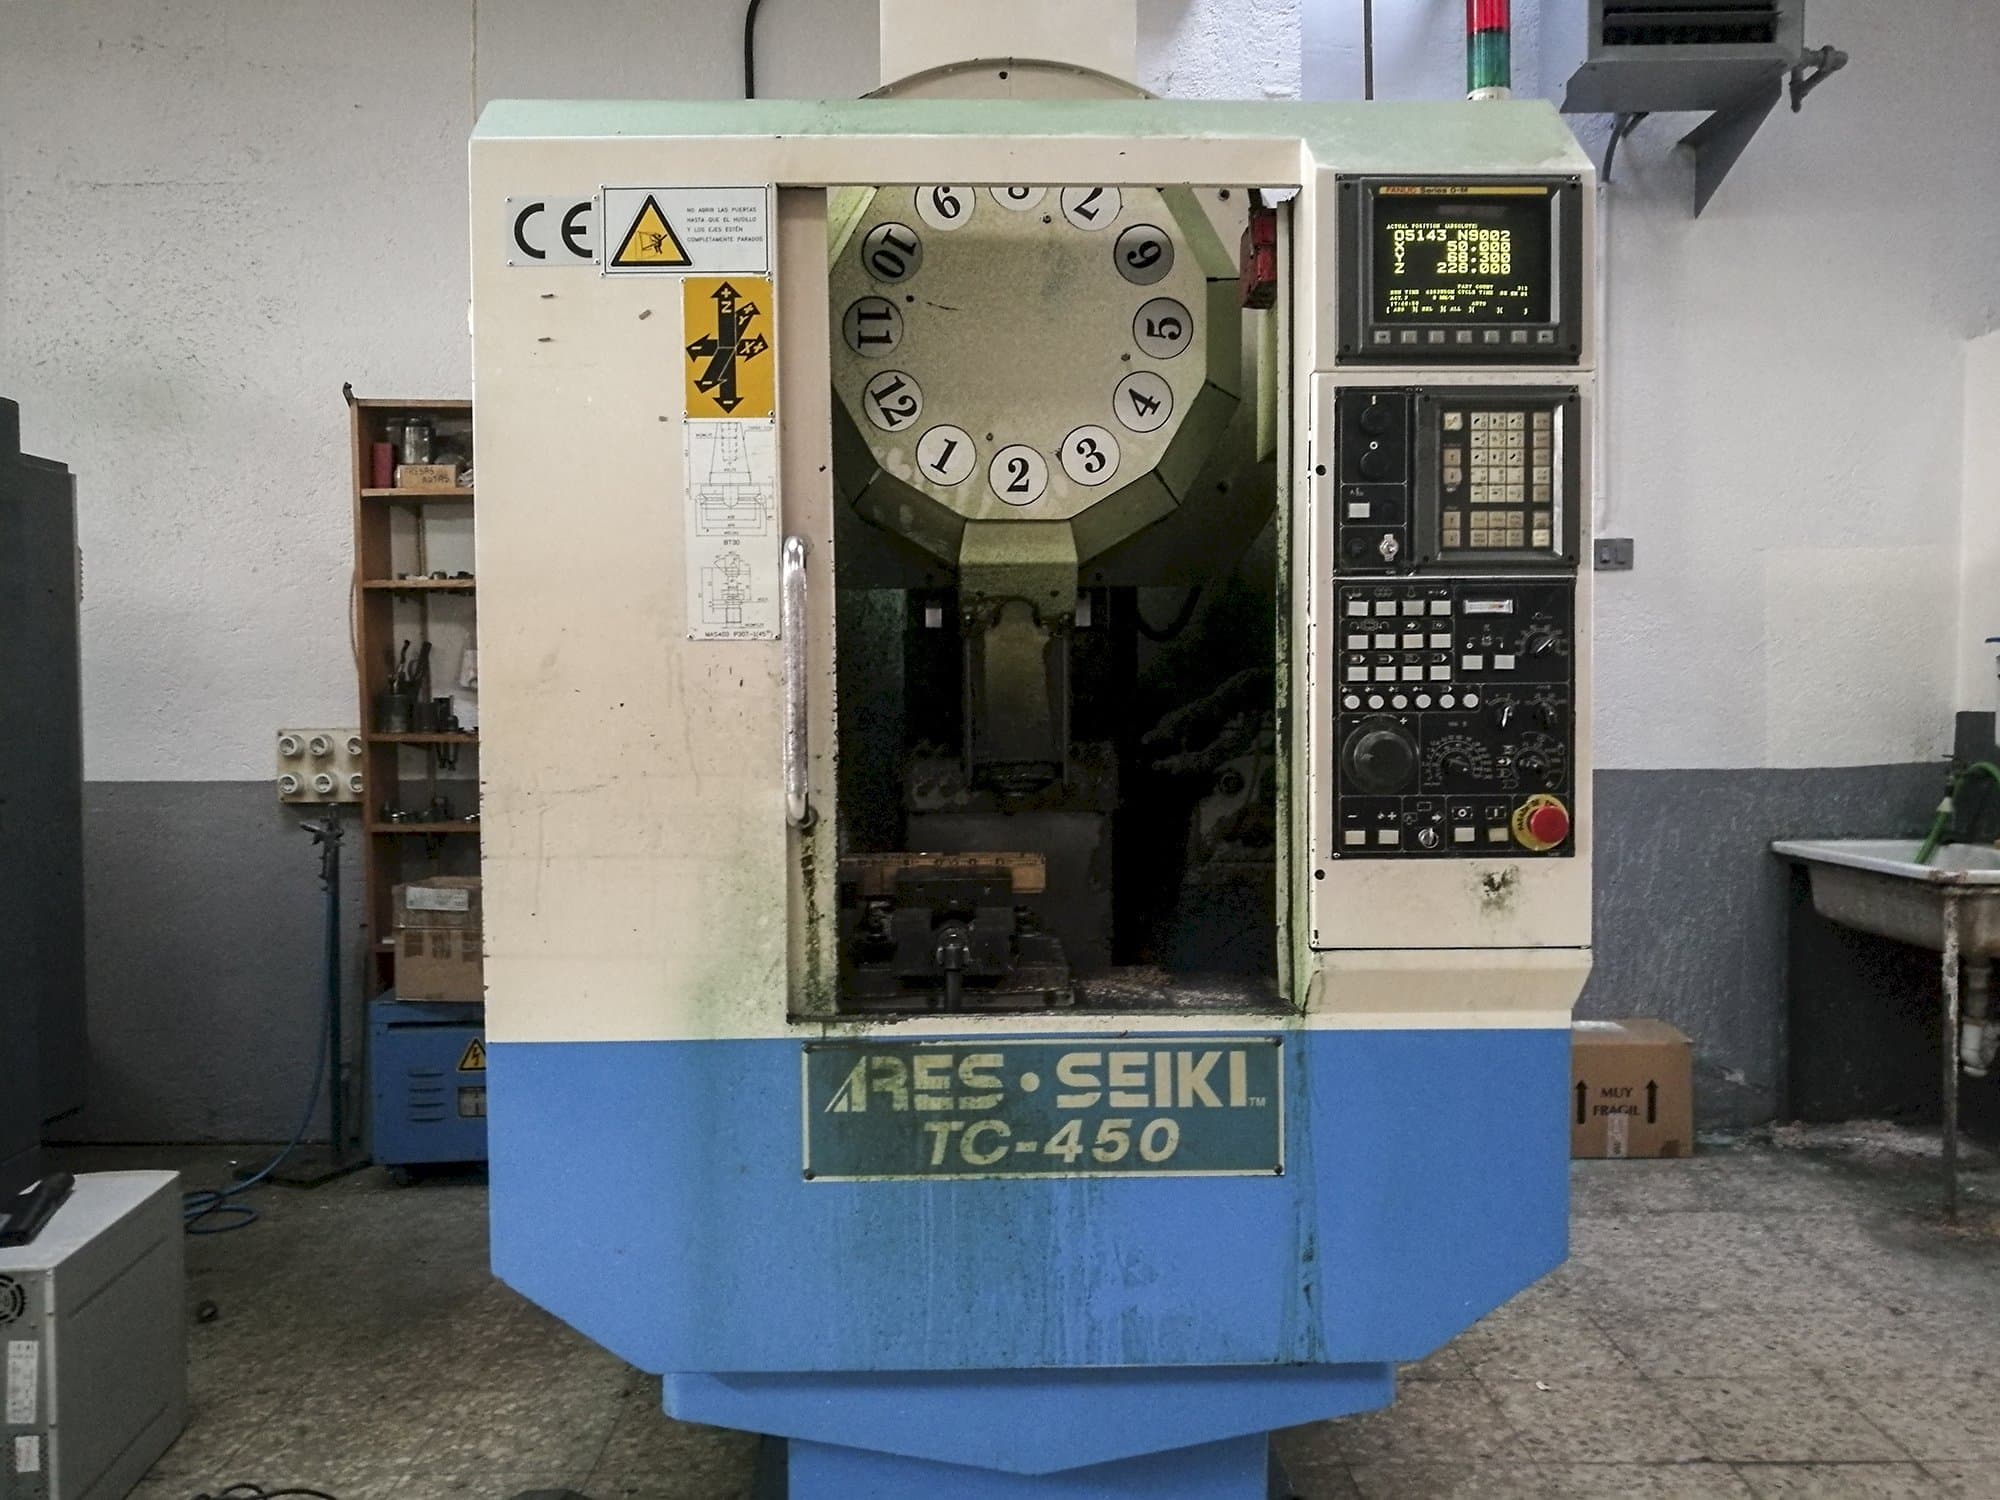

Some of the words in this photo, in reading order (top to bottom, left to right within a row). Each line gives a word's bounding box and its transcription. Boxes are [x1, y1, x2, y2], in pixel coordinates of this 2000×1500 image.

[514, 202, 593, 259] CE
[1394, 241, 1405, 251] X
[1447, 241, 1511, 252] 50.000
[1457, 230, 1511, 241] N9002
[871, 228, 917, 278] 10
[1394, 262, 1405, 274] Z
[1436, 262, 1511, 274] 228.000
[1447, 252, 1511, 263] 68.300
[857, 307, 893, 349] 11
[1146, 316, 1182, 341] 5
[870, 375, 918, 427] 12
[1128, 388, 1161, 418] 4
[931, 439, 958, 474] 1
[1076, 438, 1106, 473] 3
[1007, 458, 1030, 492] 2
[824, 1053, 1005, 1113] ARES
[1056, 1050, 1248, 1108] SEIKI
[1248, 1096, 1266, 1107] TM
[1600, 1087, 1634, 1098] MUY
[924, 1117, 1181, 1165] TC-450
